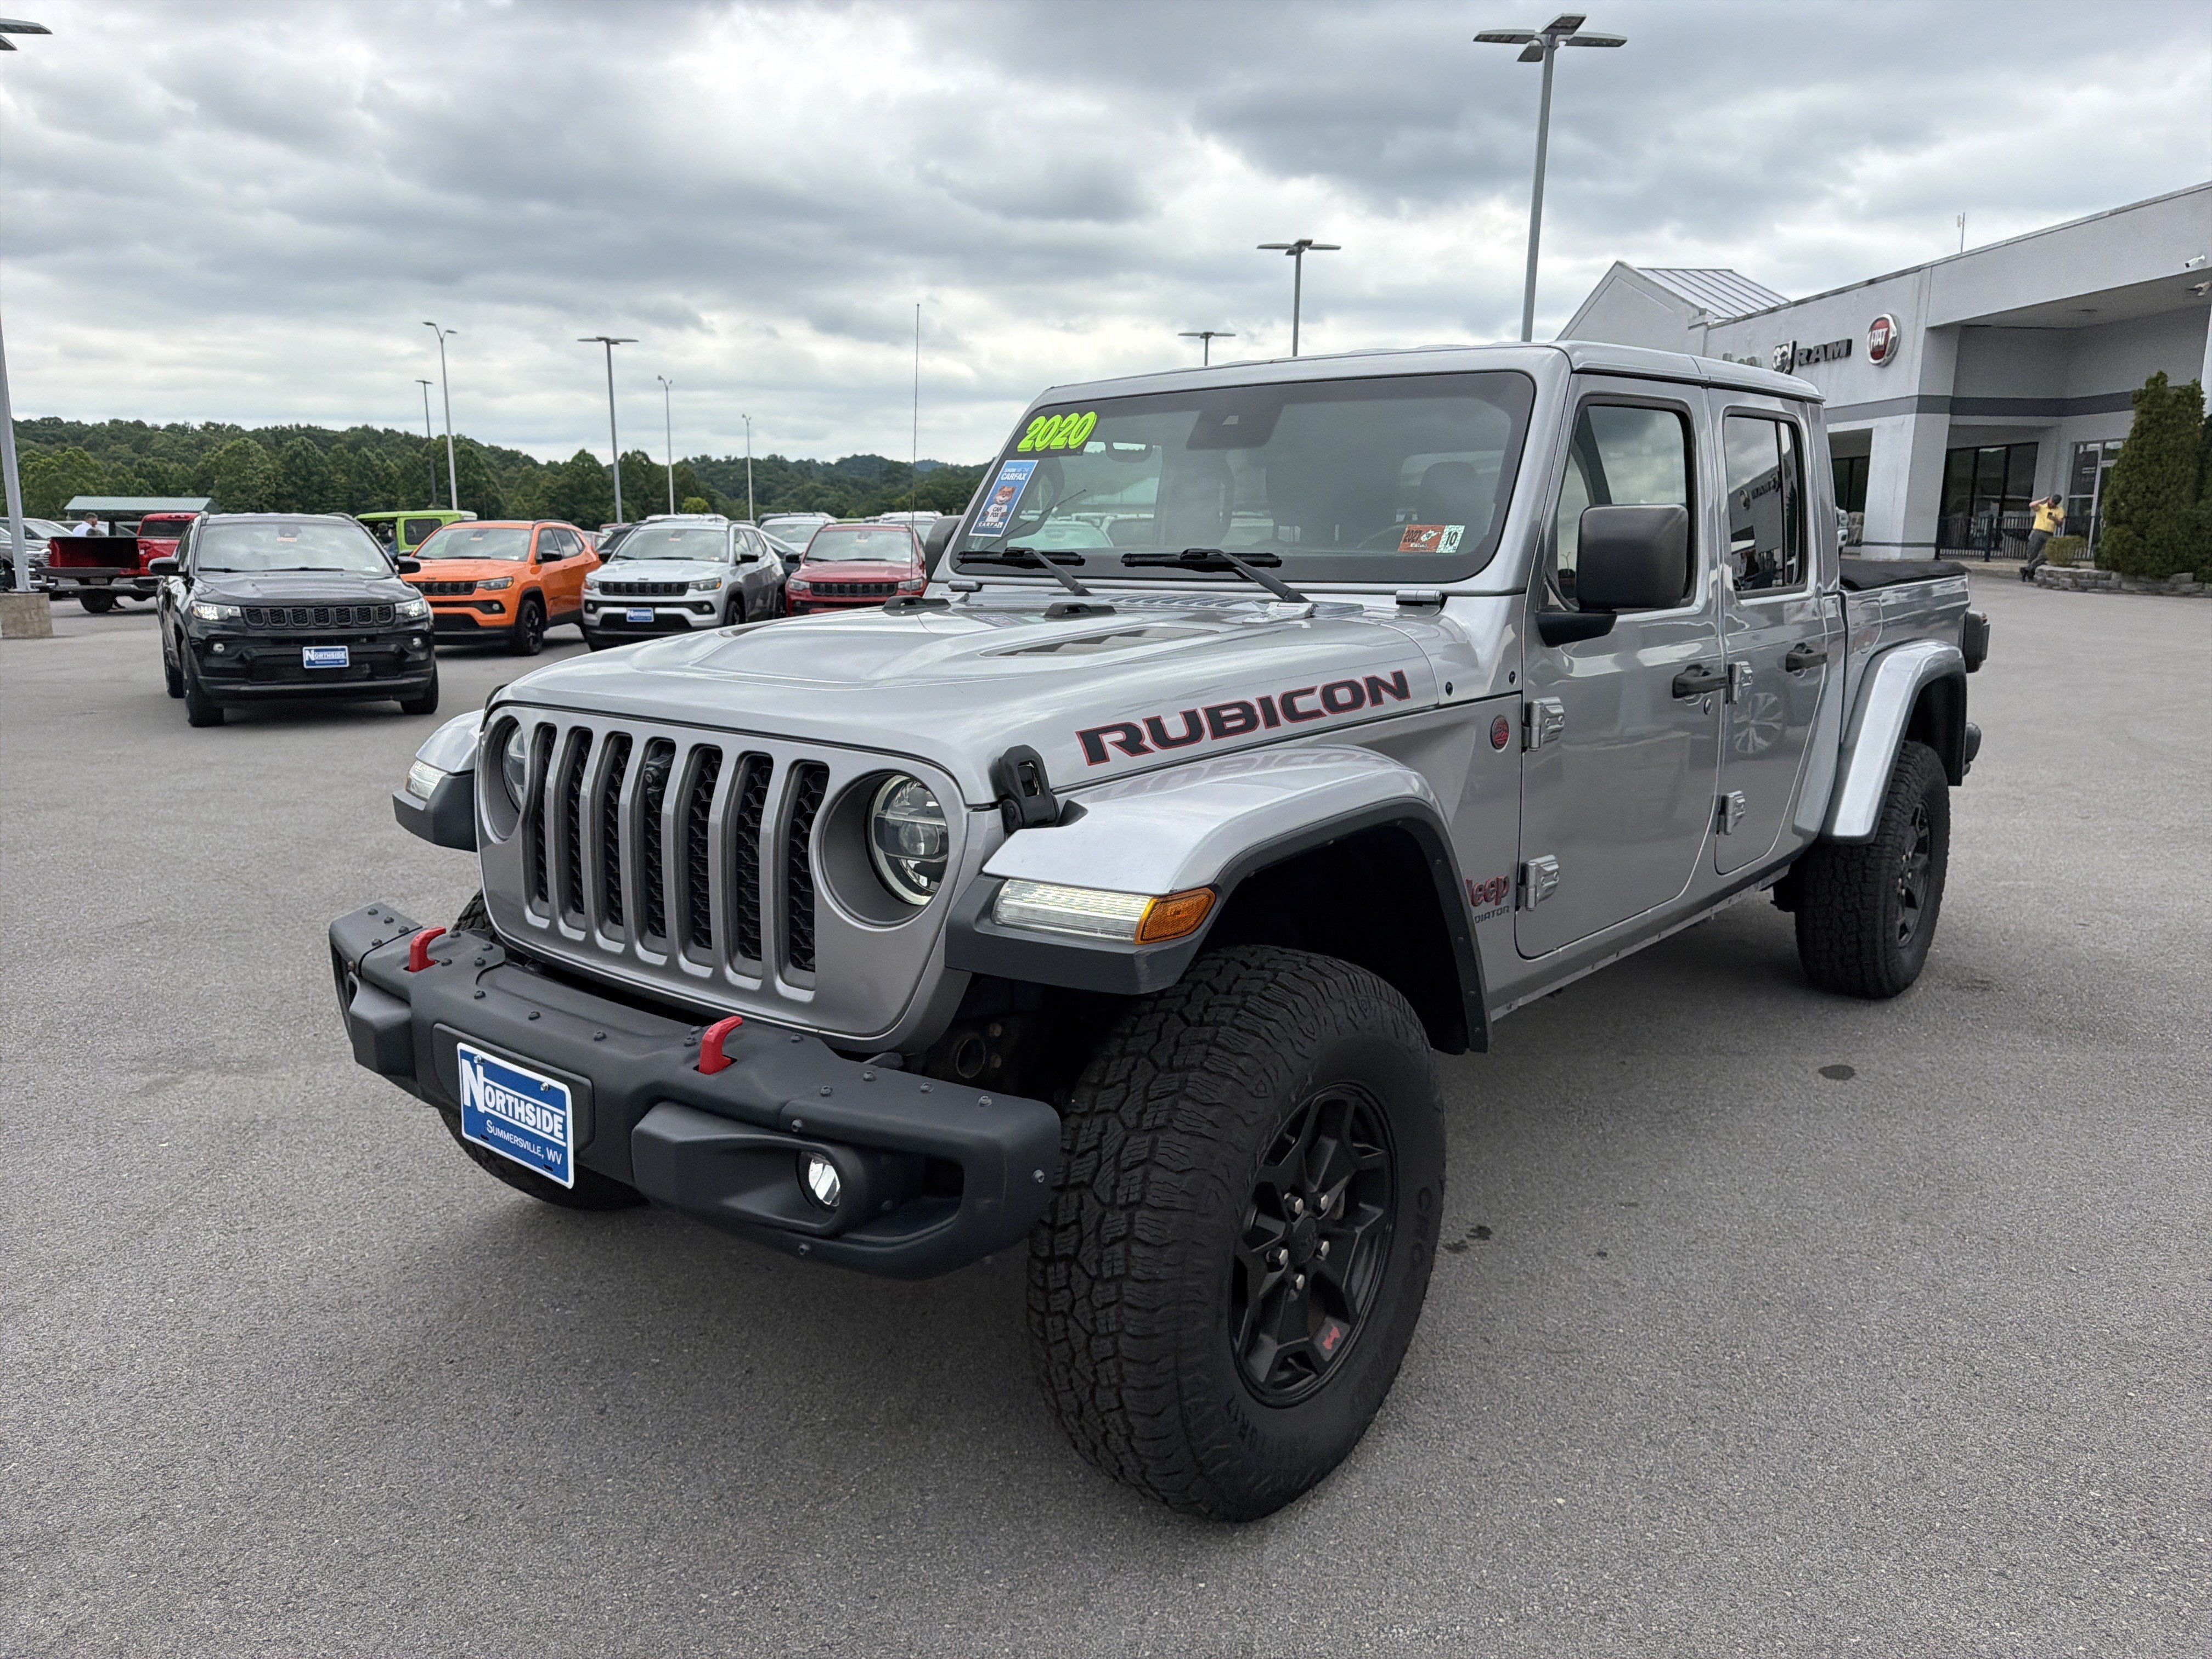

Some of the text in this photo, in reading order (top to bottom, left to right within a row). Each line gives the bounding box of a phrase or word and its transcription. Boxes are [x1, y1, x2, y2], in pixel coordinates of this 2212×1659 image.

[1870, 328, 1888, 351] FIAT
[1795, 338, 1852, 366] RAM
[1017, 411, 1097, 452] 2020
[1402, 529, 1423, 543] 2027
[1445, 531, 1458, 546] 10
[1075, 669, 1410, 766] RUBICON
[1474, 905, 1510, 923] DIATOR
[461, 1058, 564, 1140] NORTHSIDE
[546, 1148, 562, 1165] WV
